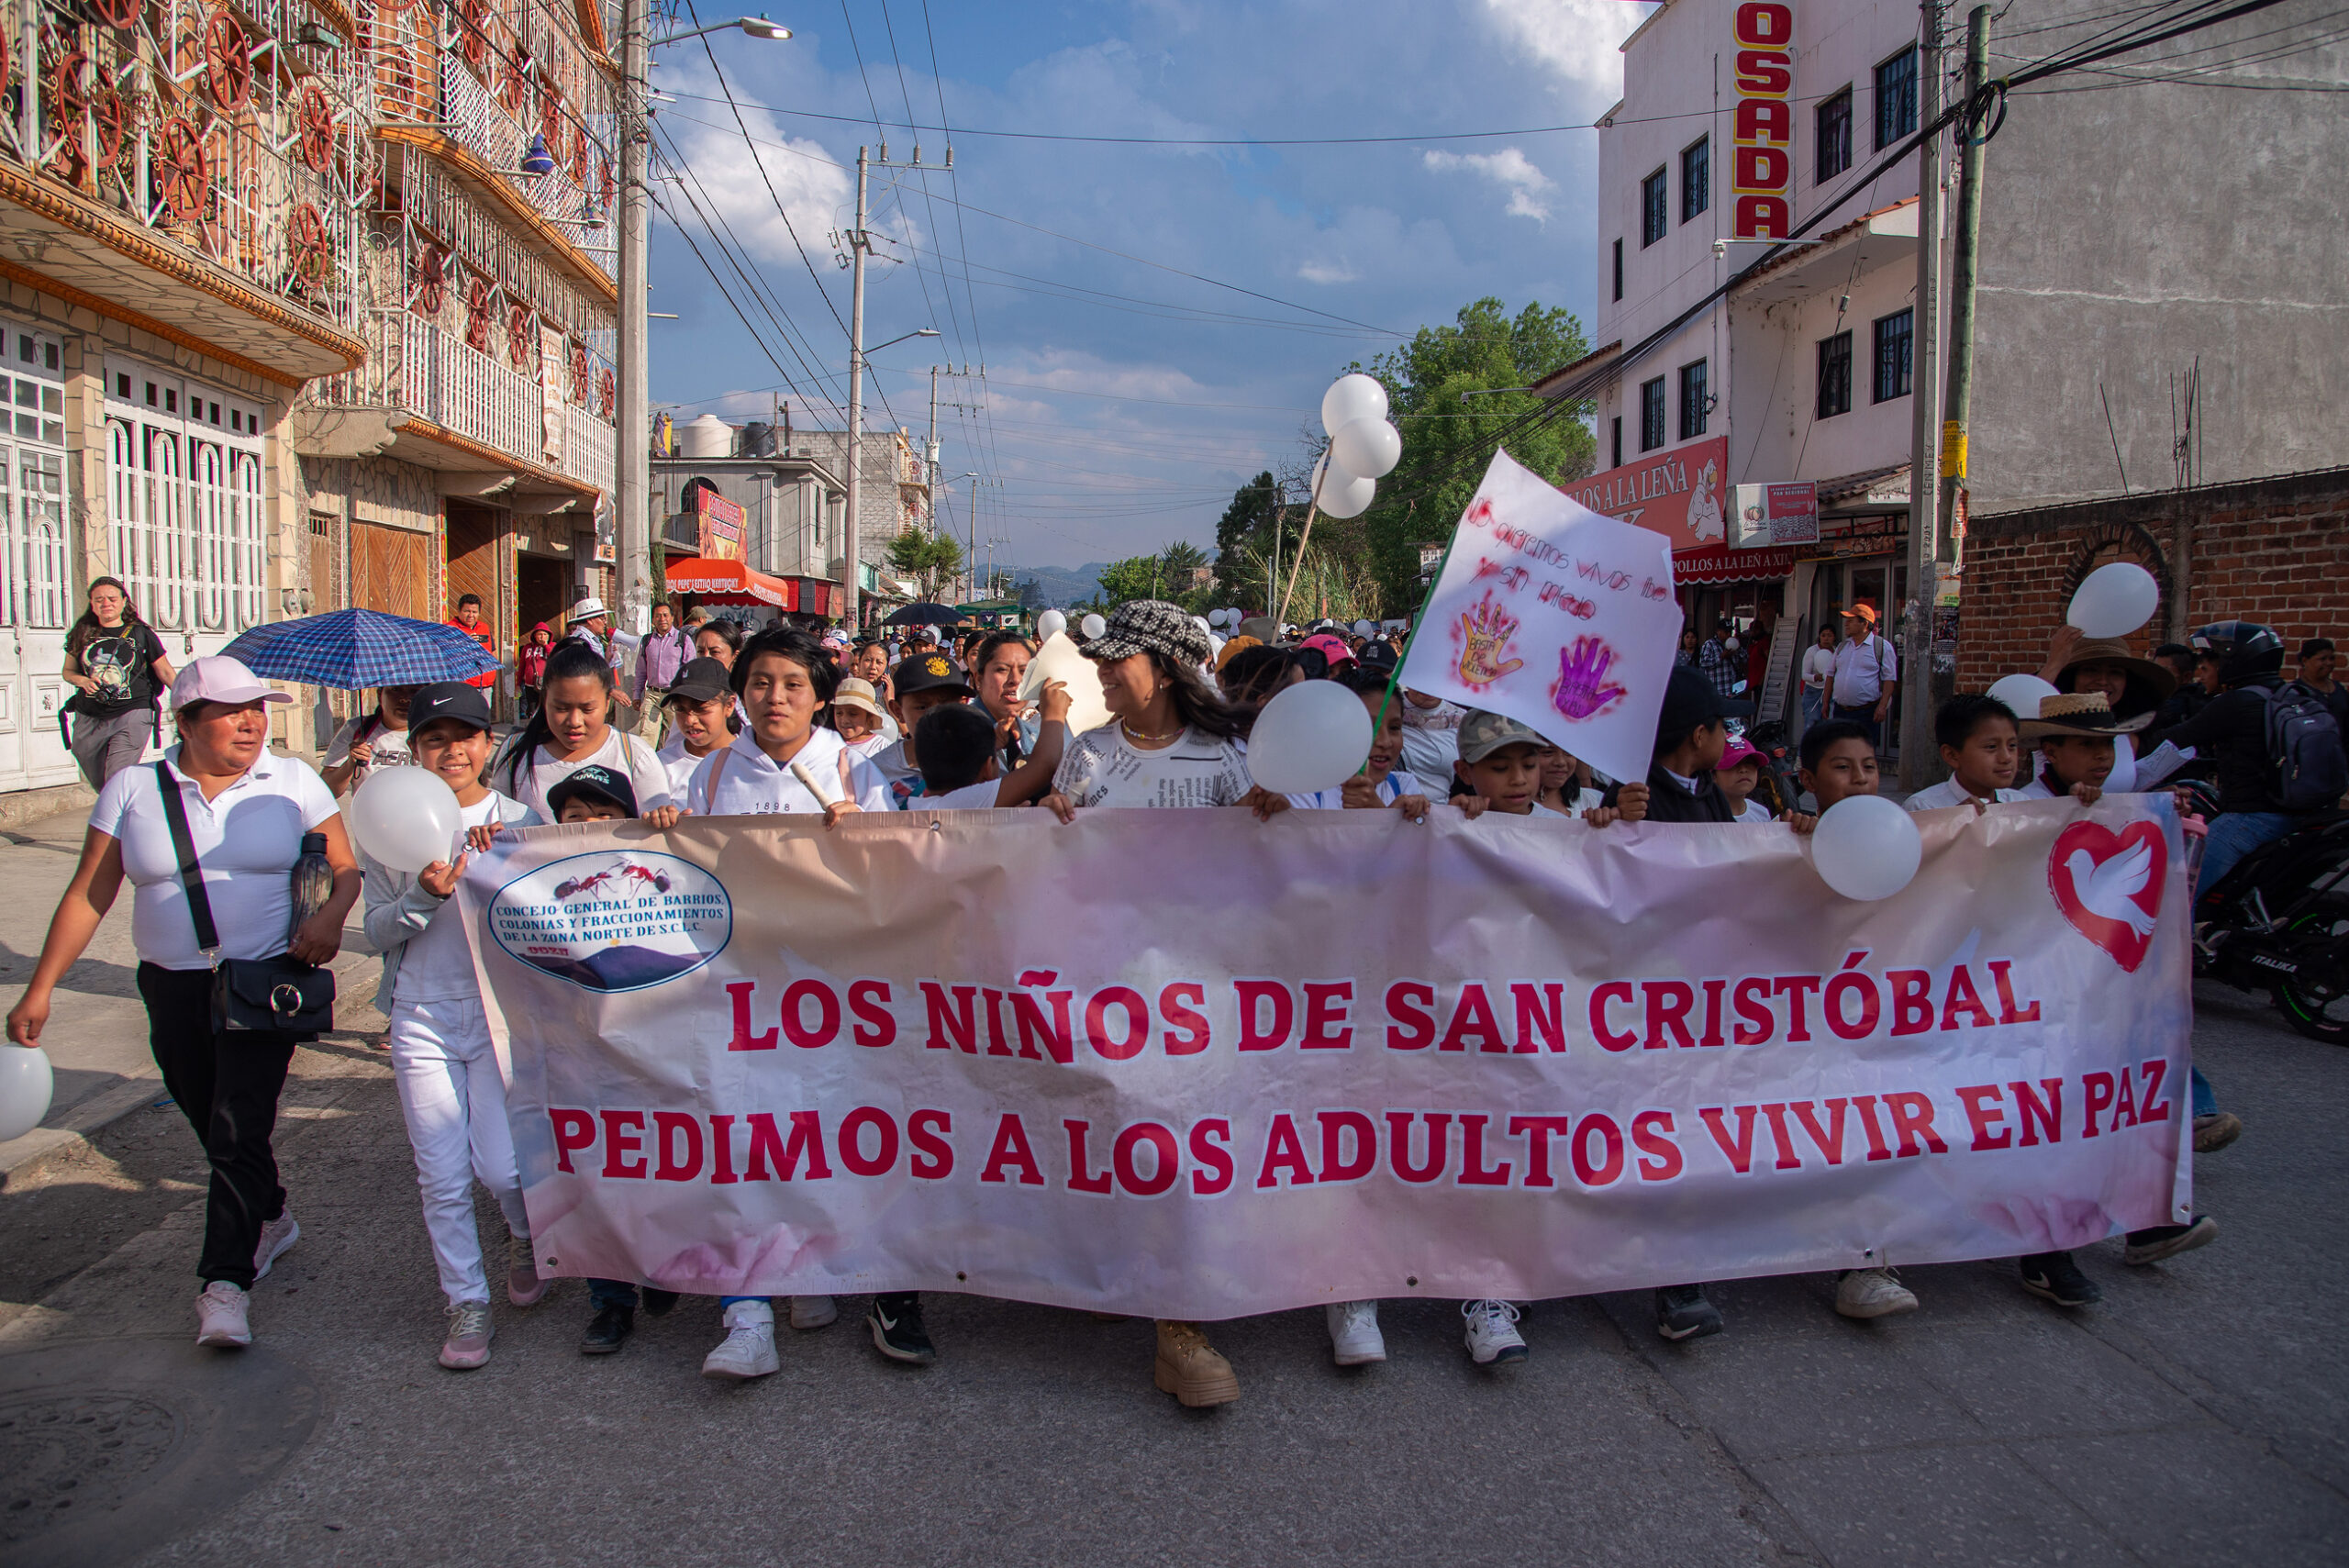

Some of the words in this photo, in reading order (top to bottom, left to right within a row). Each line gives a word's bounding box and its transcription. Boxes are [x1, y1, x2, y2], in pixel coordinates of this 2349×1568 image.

[1732, 2, 1792, 245] OSADA
[1603, 481, 1614, 511] A
[1617, 474, 1638, 507] LA
[1641, 455, 1689, 502] LEÑA
[1673, 558, 1713, 573] POLLOS
[1714, 558, 1722, 570] A
[1724, 556, 1740, 570] LA
[1498, 565, 1530, 592] sin
[1537, 581, 1597, 620] miedo
[755, 802, 790, 812] 1898
[496, 905, 557, 917] CONCEJO
[563, 899, 631, 915] GENERAL
[639, 896, 657, 908] DE
[499, 918, 564, 930] COLONIAS
[569, 917, 577, 929] Y
[582, 908, 724, 928] FRACCIONAMIENTOS
[503, 931, 520, 941] DE
[522, 932, 539, 942] LA
[541, 932, 578, 943] ZONA
[583, 927, 632, 942] NORTE
[637, 925, 656, 937] DE
[2252, 954, 2298, 973] ITALIKA
[727, 980, 897, 1052] LOS
[919, 969, 1209, 1064] NIÑOS
[1235, 982, 1353, 1052] DE
[1386, 983, 1564, 1053] SAN
[1589, 951, 2041, 1052] CRISTÓBAL
[549, 1106, 952, 1185] PEDIMOS
[981, 1114, 1043, 1185] A
[1064, 1120, 1232, 1196] LOS
[1256, 1113, 1683, 1187] ADULTOS
[1699, 1092, 1946, 1173] VIVIR
[1956, 1077, 2065, 1151] EN
[2081, 1060, 2170, 1139] PAZ
